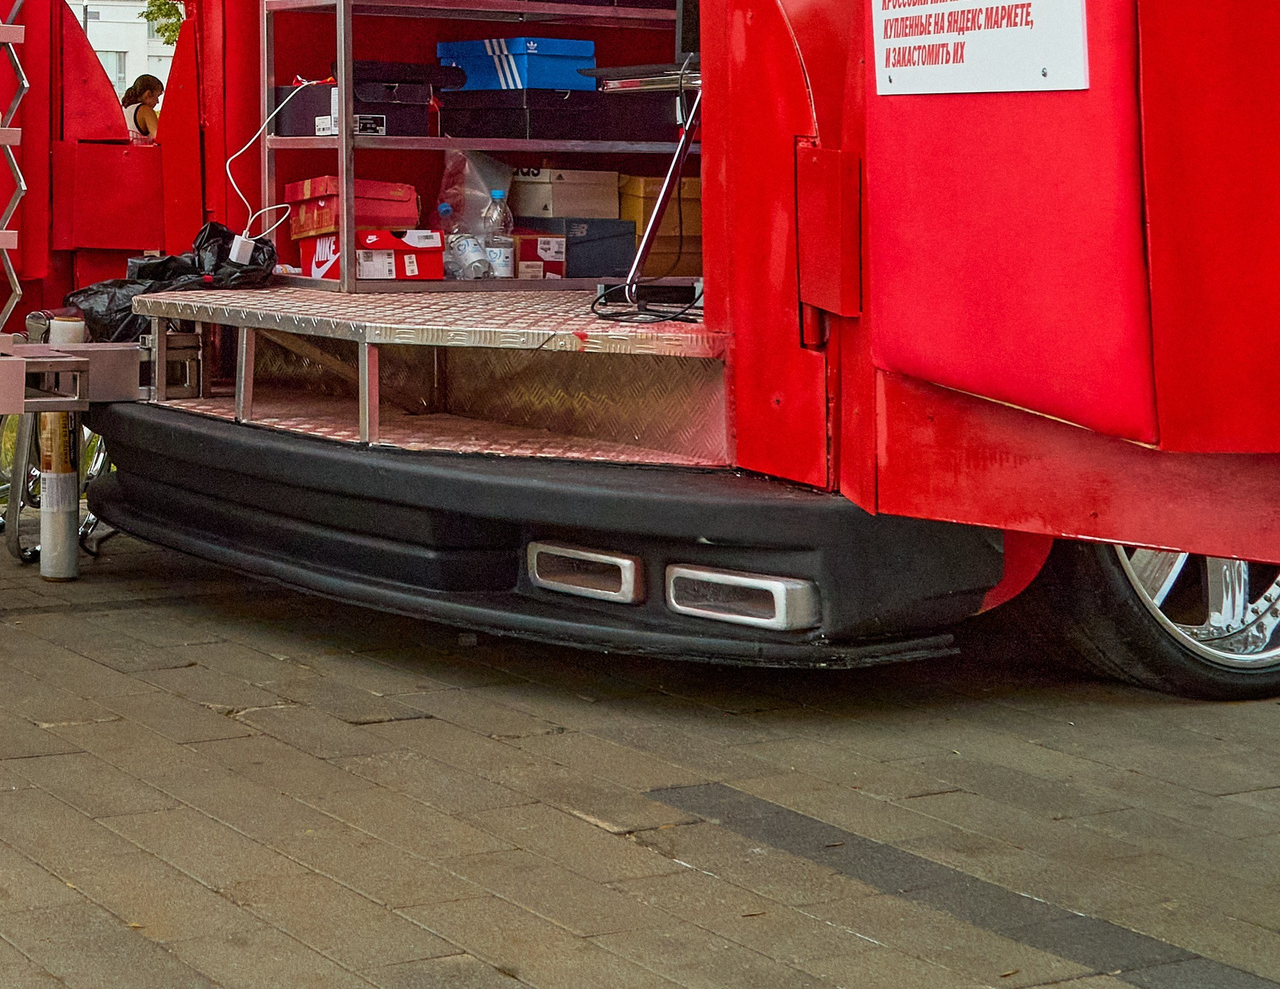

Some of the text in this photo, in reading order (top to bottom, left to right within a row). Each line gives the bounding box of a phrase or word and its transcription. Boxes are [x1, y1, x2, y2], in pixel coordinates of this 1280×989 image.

[883, 2, 1034, 39] КУПЛЕННЫЕ НА ЯНДЕКС МАРКЕТЕ,
[885, 41, 966, 68] И ЗАКАСТОМИТЬ ИХ
[315, 236, 336, 261] NIKE
